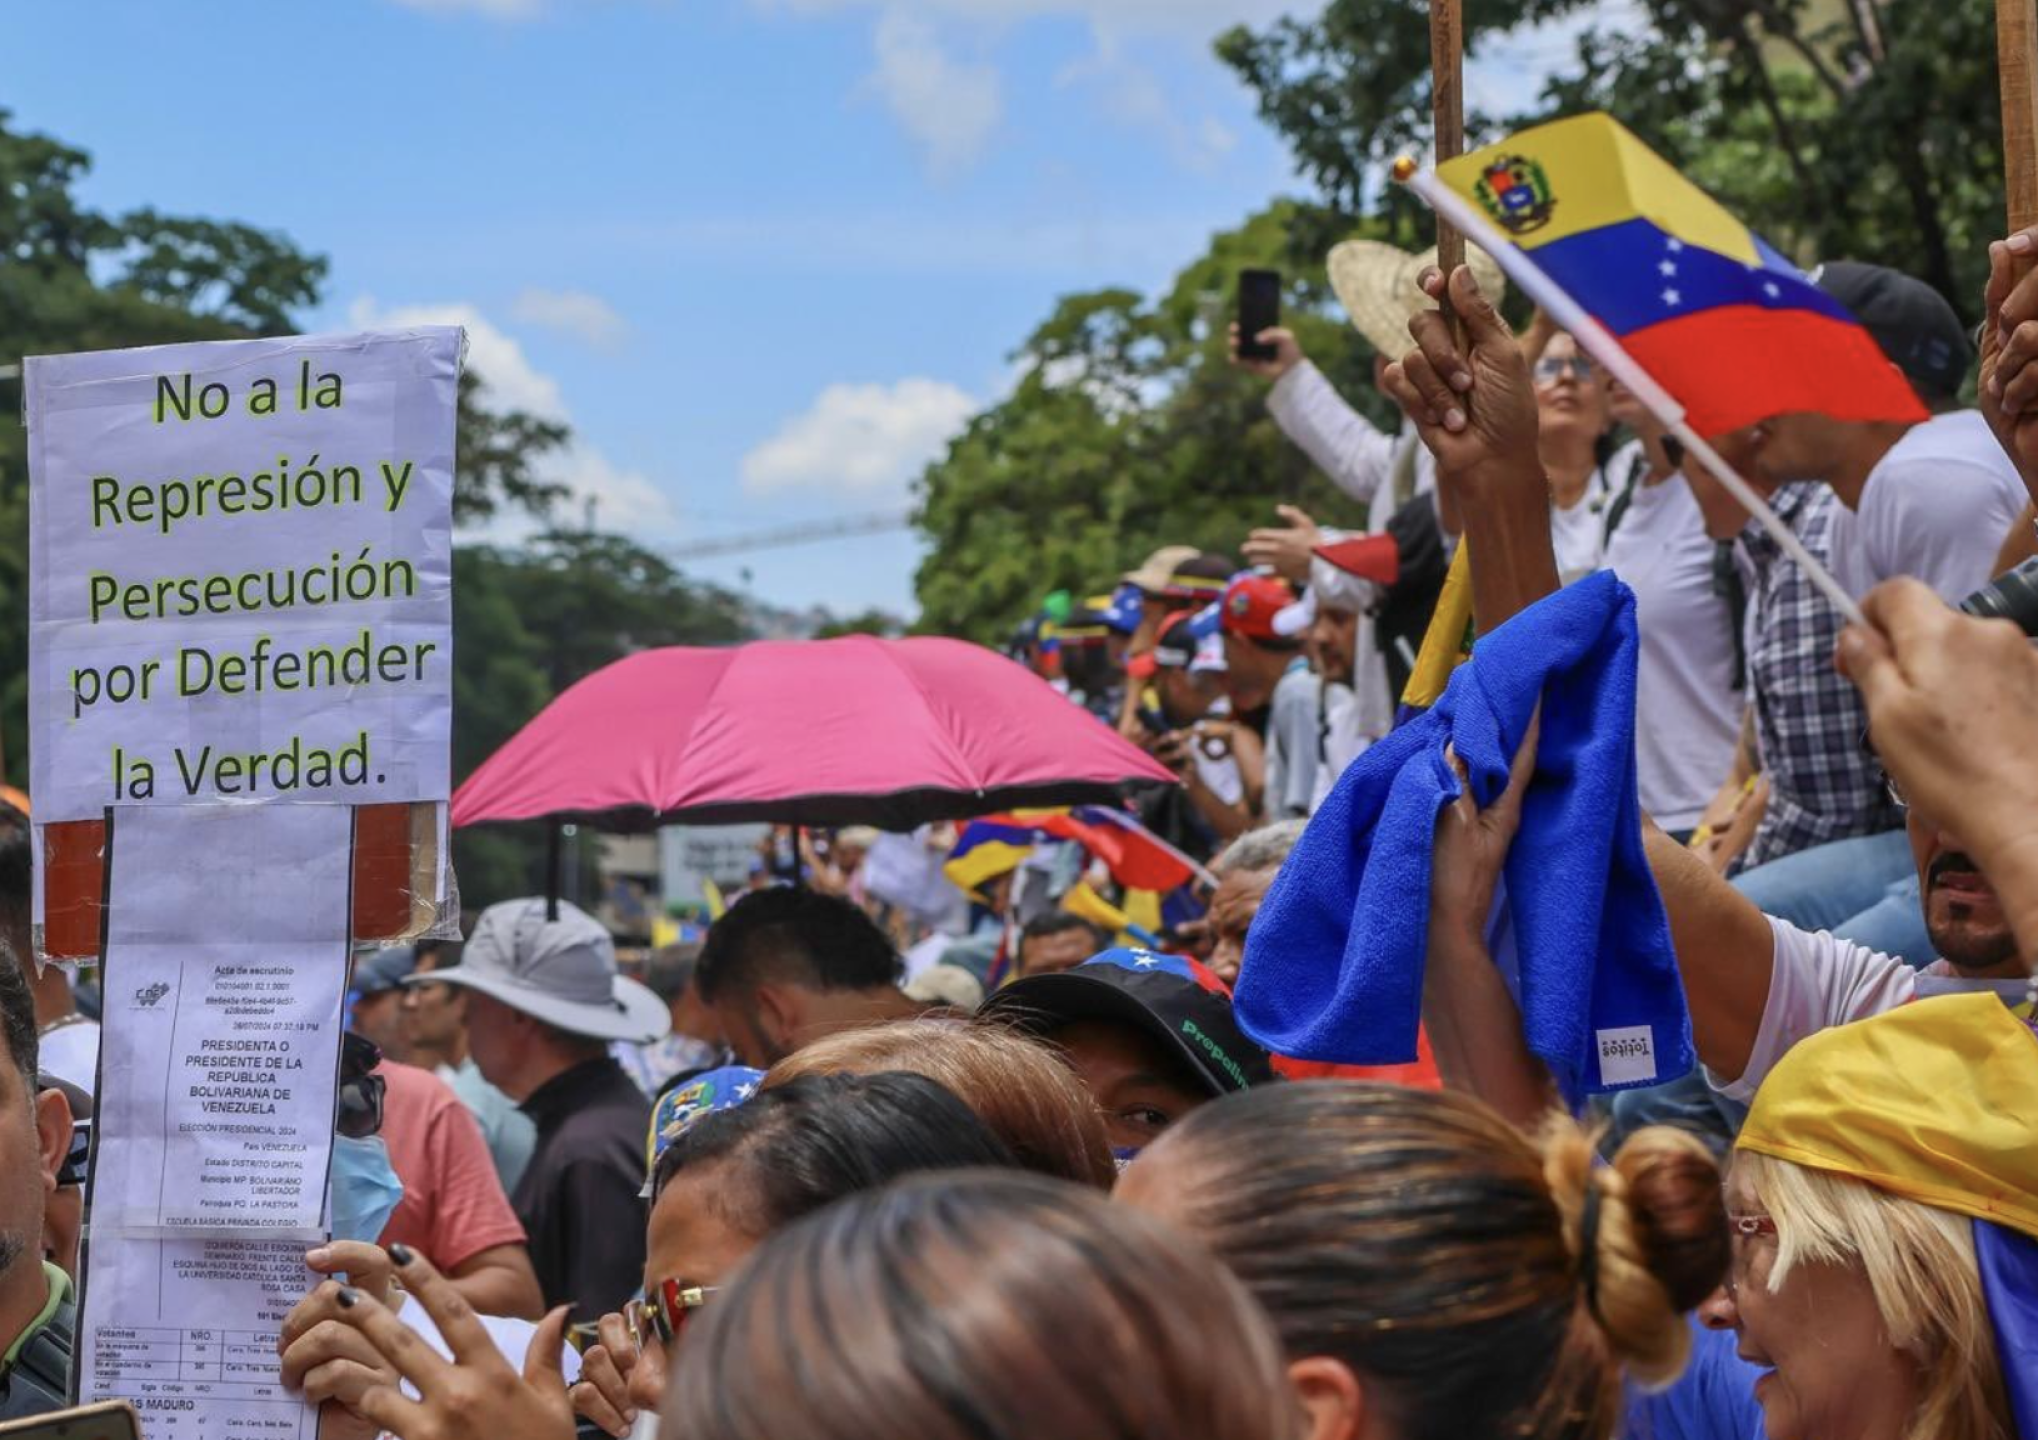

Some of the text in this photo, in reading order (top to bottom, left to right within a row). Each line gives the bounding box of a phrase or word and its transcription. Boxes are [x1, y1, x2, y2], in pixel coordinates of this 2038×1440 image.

[156, 360, 343, 423] No a la
[92, 455, 413, 533] Represión y
[89, 548, 415, 624] Persecución
[73, 631, 437, 719] por Defender
[114, 732, 386, 800] la Verdad.
[201, 1040, 290, 1052] PRESIDENTA O
[185, 1056, 303, 1070] PRESIDENTE DE LA
[207, 1071, 276, 1084] REPUBLICA
[189, 1086, 291, 1100] BOLIVARIANA DE
[202, 1102, 276, 1115] VENEZUELA
[145, 1399, 195, 1411] MADURO
